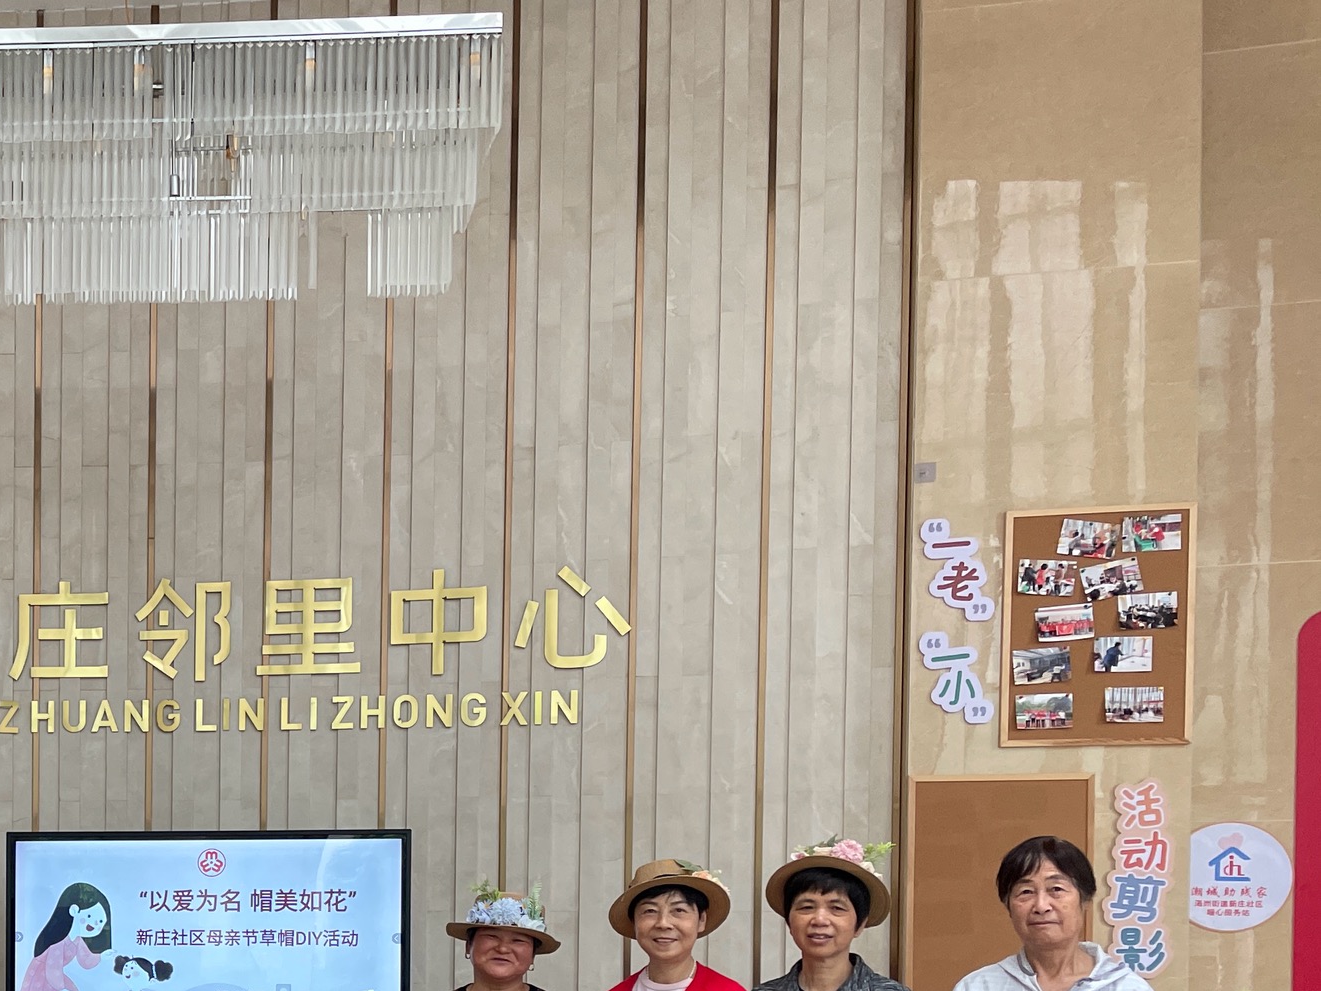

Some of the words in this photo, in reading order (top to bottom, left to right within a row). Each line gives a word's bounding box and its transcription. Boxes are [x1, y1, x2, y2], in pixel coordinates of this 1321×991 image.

[331, 693, 487, 731] ZHONG
[500, 689, 579, 727] XIN
[1110, 784, 1168, 973] 活动剪影
[139, 889, 241, 913] “以爱为名
[250, 889, 357, 913] 帽美如花”
[136, 928, 359, 948] 新庄社区母亲节草帽DIY活动
